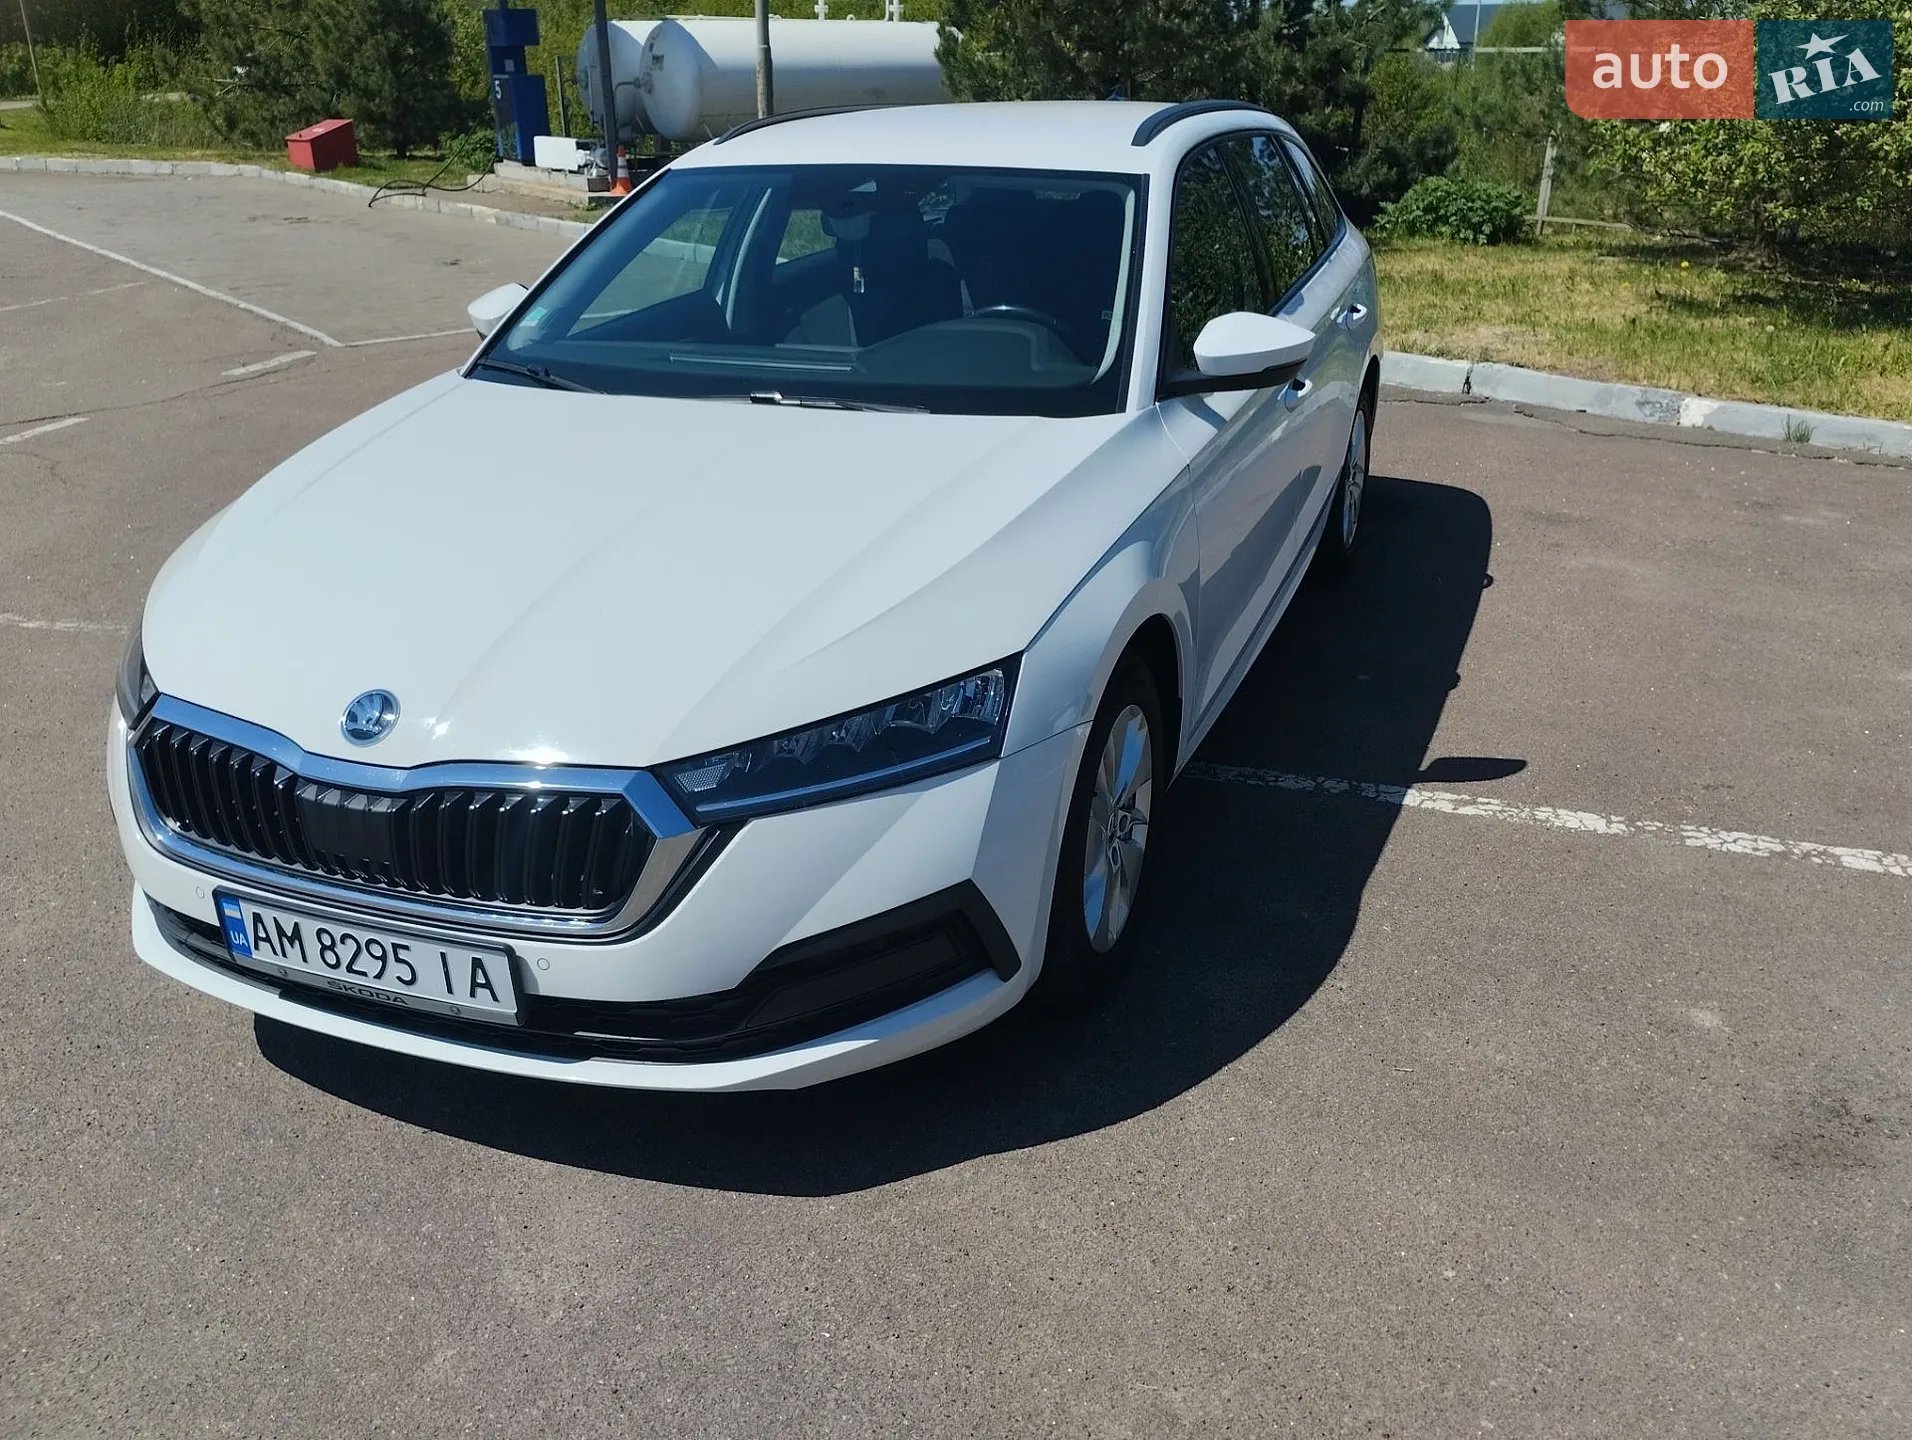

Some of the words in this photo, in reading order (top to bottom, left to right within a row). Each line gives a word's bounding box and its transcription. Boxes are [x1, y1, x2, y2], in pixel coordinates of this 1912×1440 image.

[495, 80, 502, 99] 5
[230, 930, 248, 945] UA
[252, 912, 309, 963] AM
[315, 928, 417, 986] 8295
